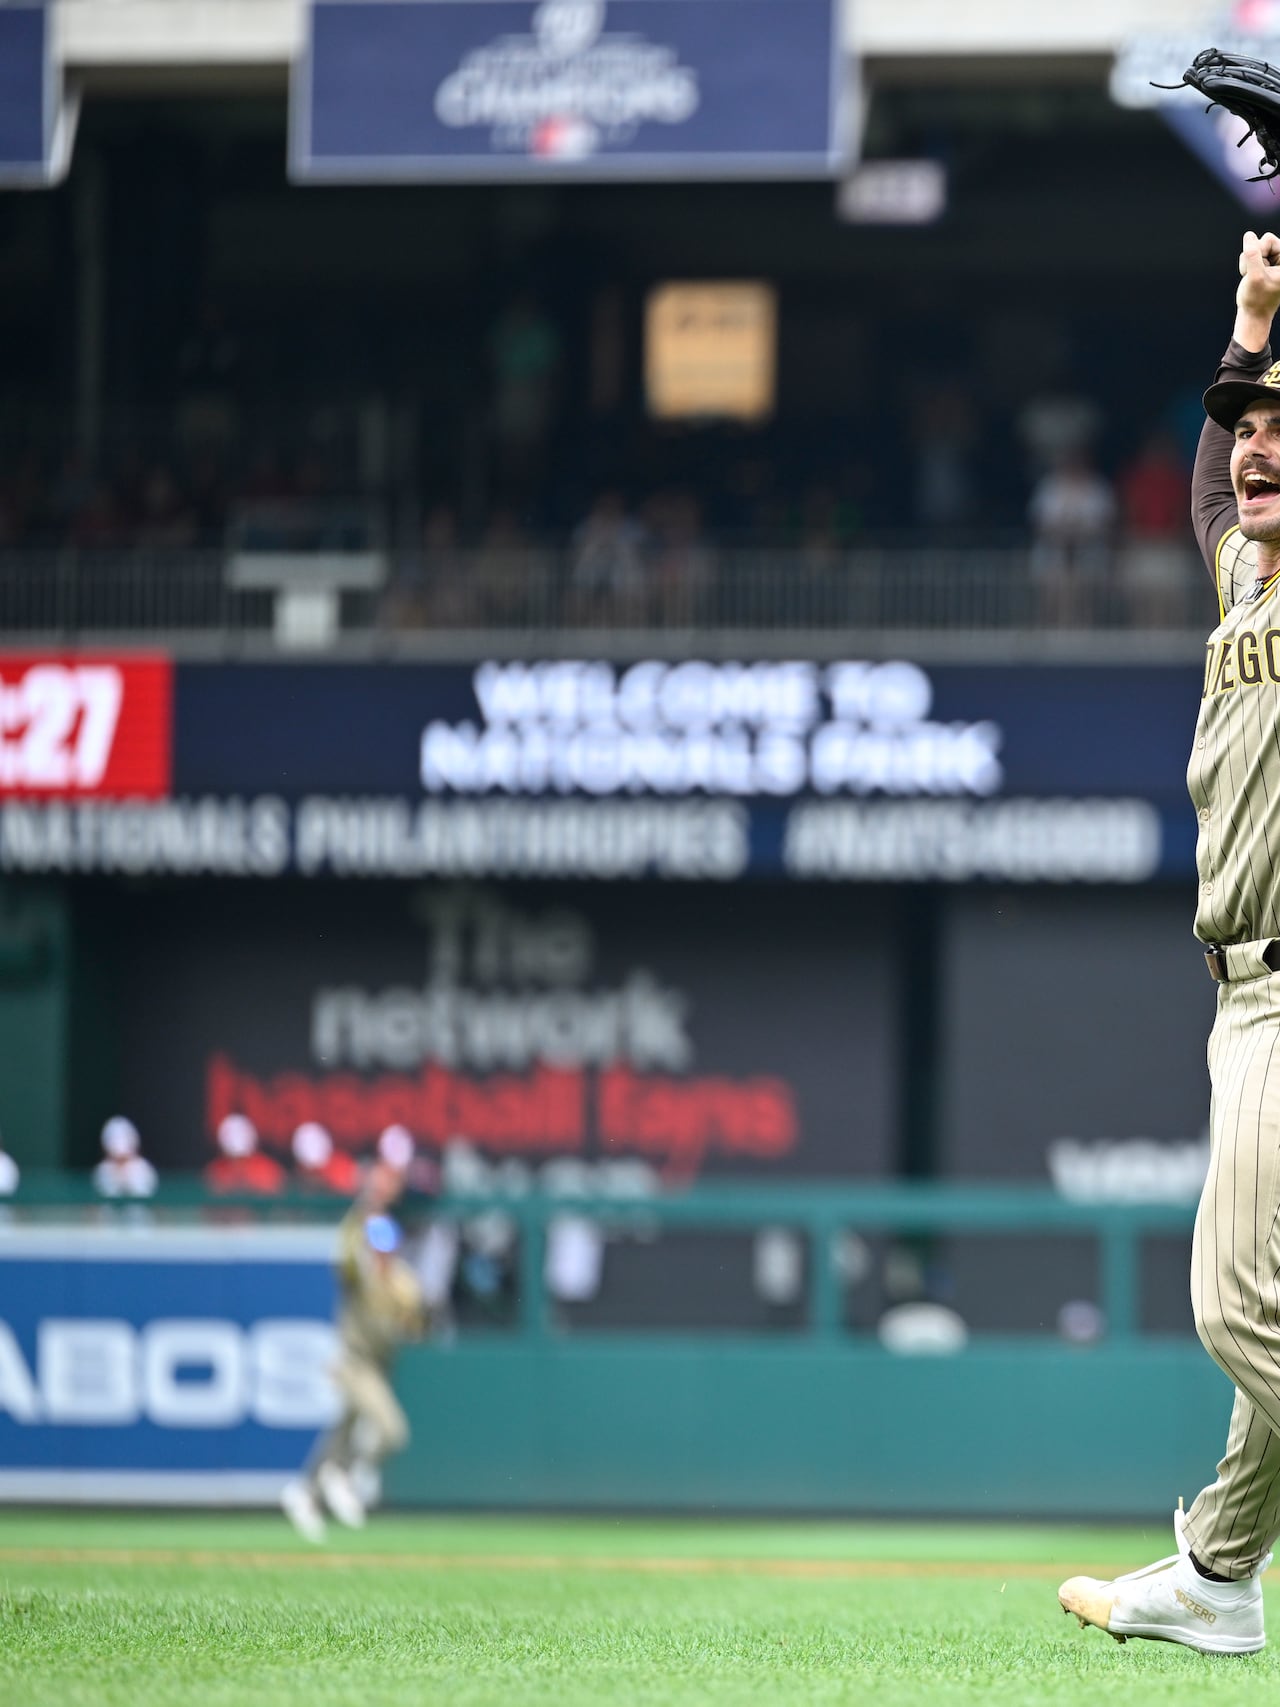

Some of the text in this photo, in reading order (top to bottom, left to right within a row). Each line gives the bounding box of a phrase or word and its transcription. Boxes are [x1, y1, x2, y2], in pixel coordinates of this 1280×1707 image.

[474, 661, 931, 728] WELCOME TO
[421, 720, 1001, 794] NATIONALS PARK
[0, 797, 289, 876] NATIONALS
[296, 798, 747, 879] PHILANTHROPIES
[413, 892, 591, 981] The
[312, 970, 691, 1069] network
[209, 1055, 795, 1157] baseball fans
